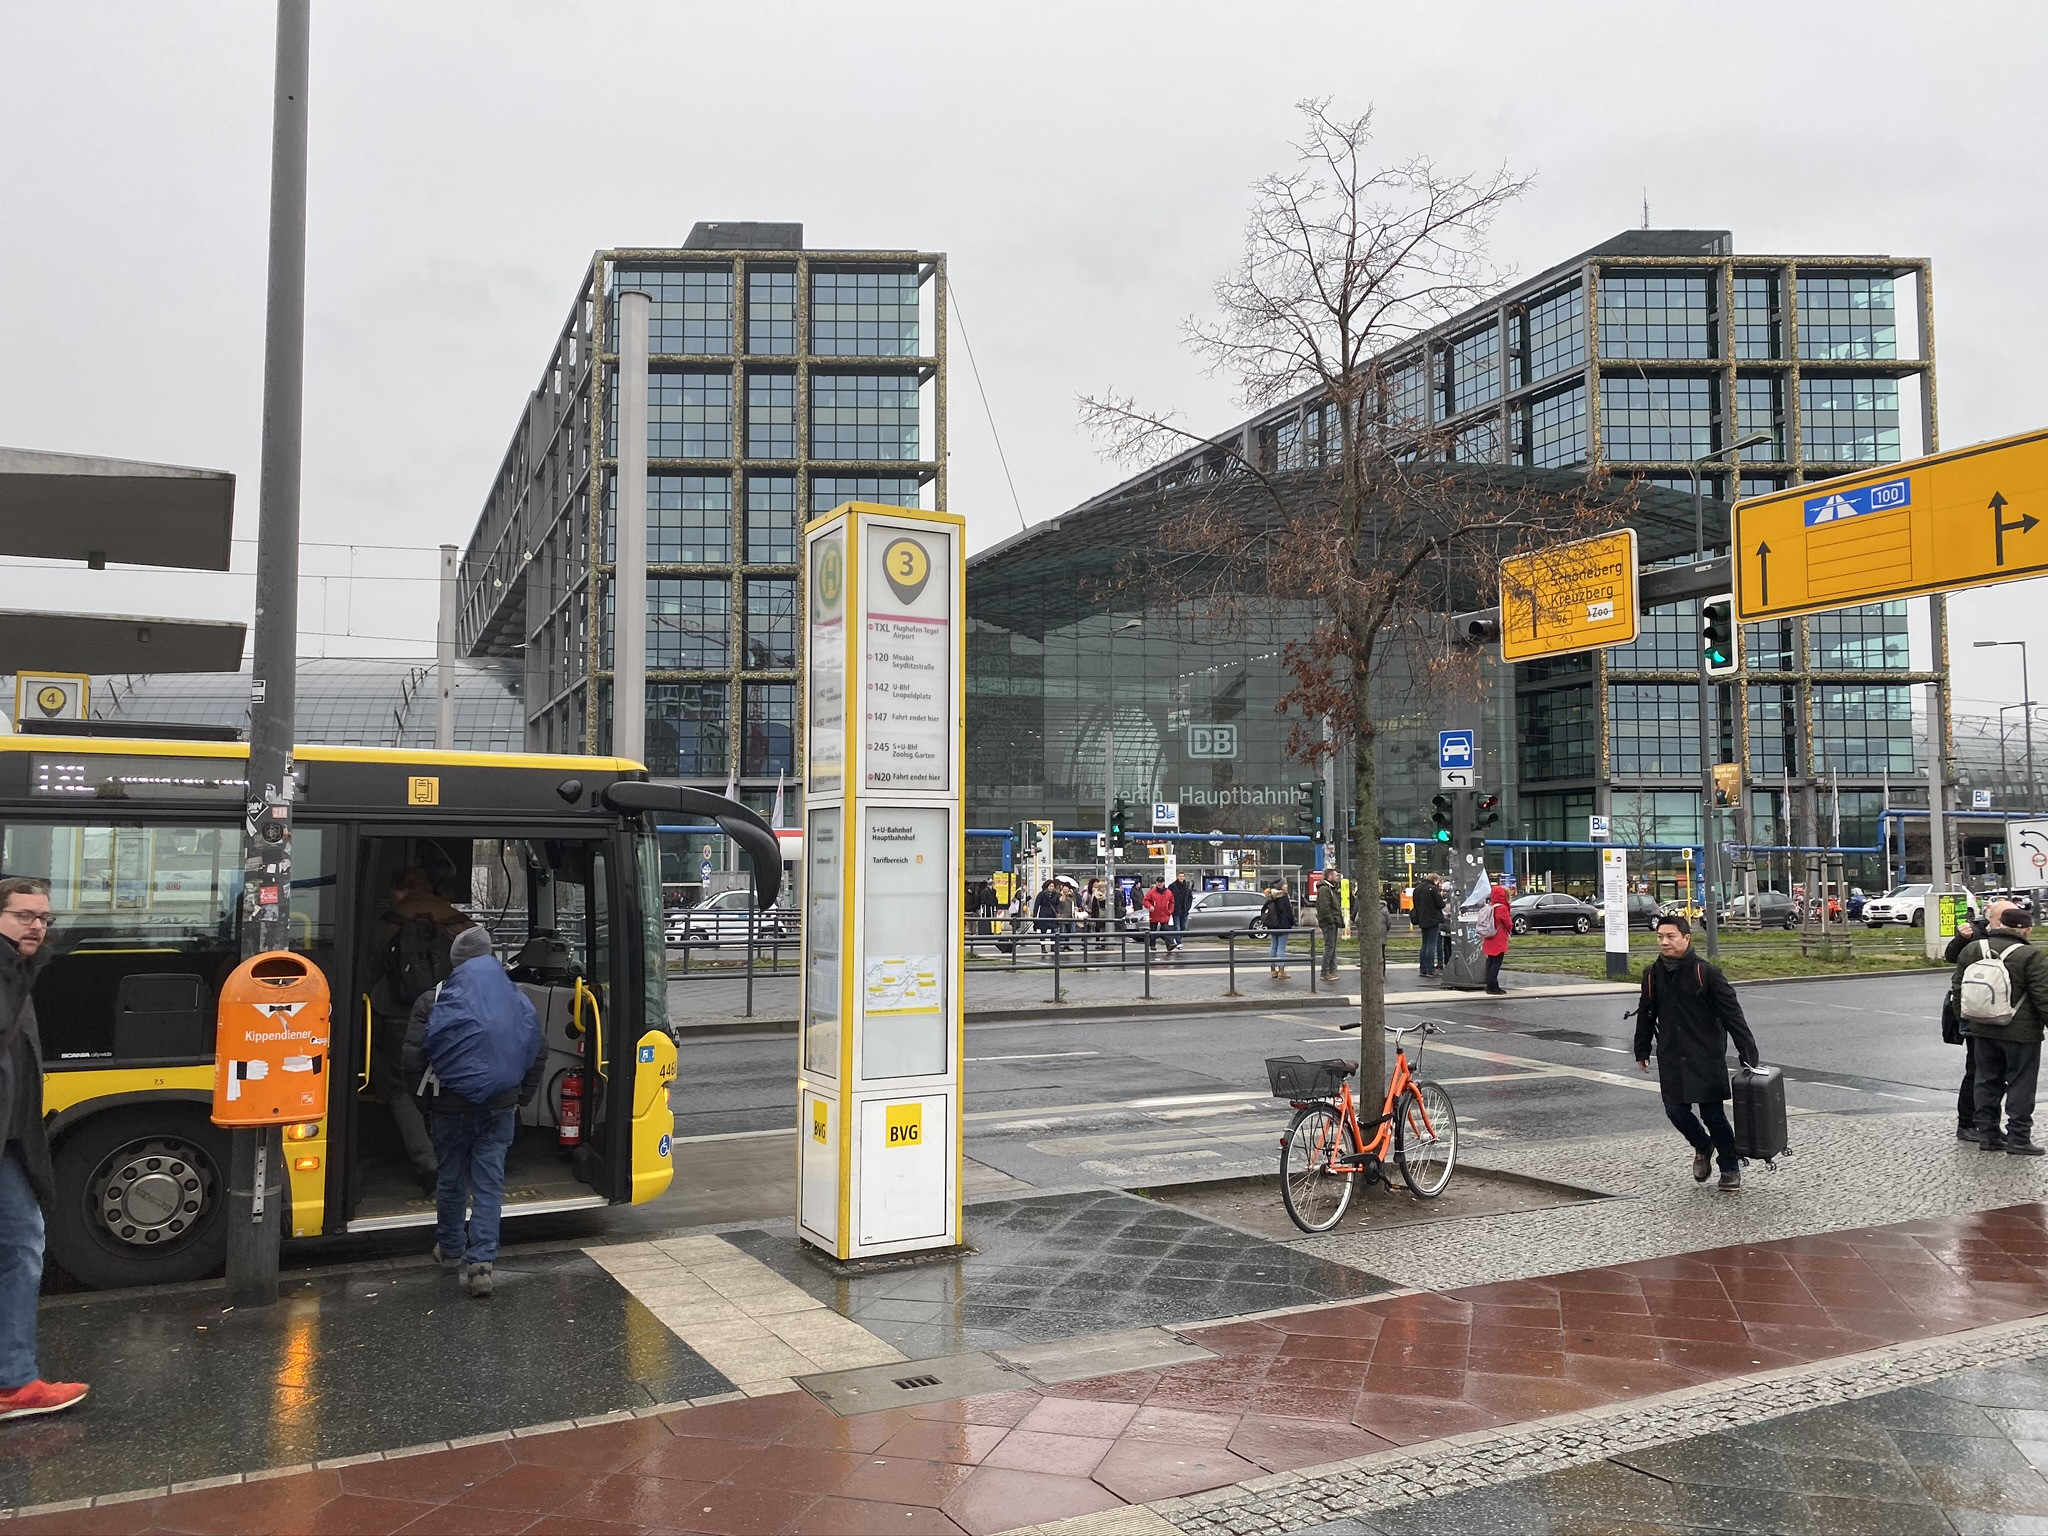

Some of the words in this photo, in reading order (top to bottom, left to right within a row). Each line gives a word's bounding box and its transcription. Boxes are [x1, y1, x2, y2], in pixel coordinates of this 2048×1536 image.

[1877, 488, 1898, 504] 100
[900, 551, 914, 577] 3
[1551, 586, 1613, 607] Kreuzberg
[1592, 607, 1609, 618] Zoo
[874, 623, 890, 633] TXL
[893, 624, 923, 633] Flughafen
[924, 627, 939, 635] Tegel
[893, 632, 915, 640] Airport
[874, 652, 889, 662] 120
[892, 662, 935, 670] Seydlitzstraße
[874, 683, 889, 692] 142
[893, 683, 910, 691] U-Bhf
[46, 692, 56, 705] 4
[893, 692, 932, 700] Leopoldplatz
[874, 712, 887, 721] 147
[909, 714, 926, 722] endet
[1194, 729, 1232, 753] DB
[874, 742, 889, 752] 245
[892, 743, 918, 751] S+U-Bhf
[892, 751, 913, 759] Zoolog
[915, 751, 935, 759] Garten
[874, 772, 891, 782] N20
[1179, 785, 1311, 808] Hauptbahnh
[872, 834, 916, 842] Hauptbahnhof
[873, 856, 909, 864] Tarifbereich
[245, 1029, 312, 1043] Kippendiener
[91, 1051, 112, 1059] citywide
[154, 1078, 164, 1086] 7,5
[814, 1120, 826, 1139] BVG
[890, 1124, 918, 1142] BVG
